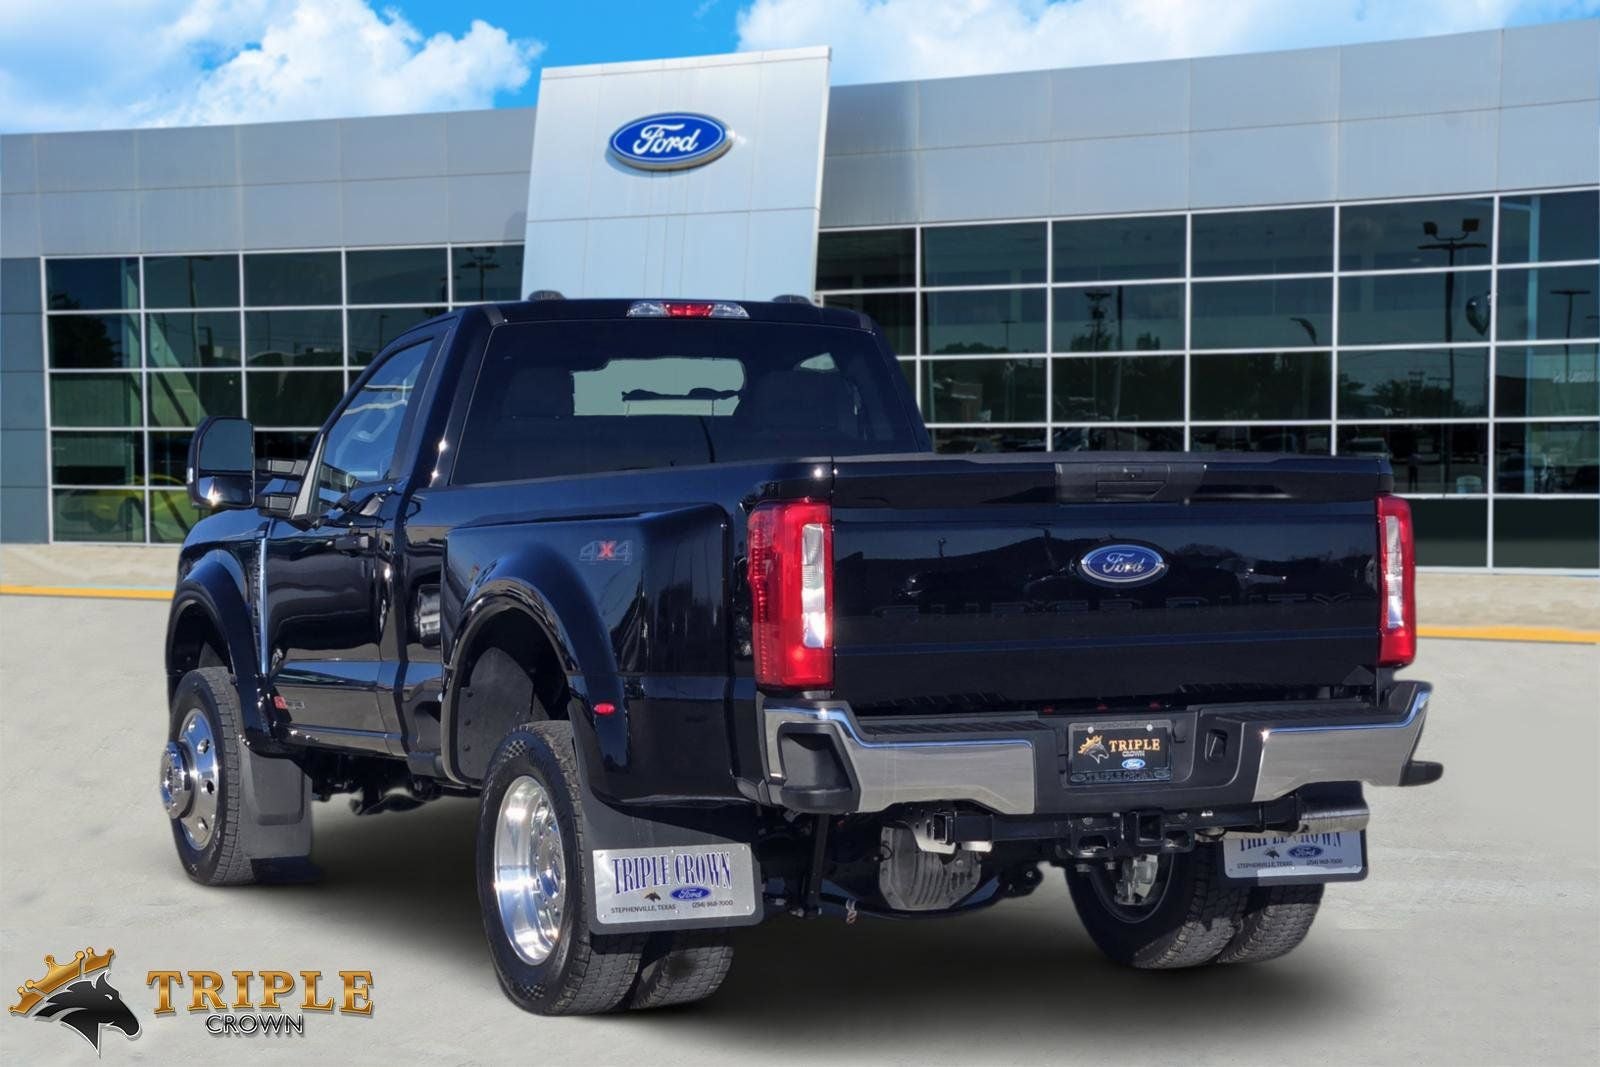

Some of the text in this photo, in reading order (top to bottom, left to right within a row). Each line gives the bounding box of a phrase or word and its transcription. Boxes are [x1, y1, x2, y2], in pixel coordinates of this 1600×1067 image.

[633, 124, 701, 154] Ford
[1103, 552, 1145, 573] Ford
[1109, 739, 1160, 752] TRIPLE
[612, 853, 732, 894] TRIPLE CROWN
